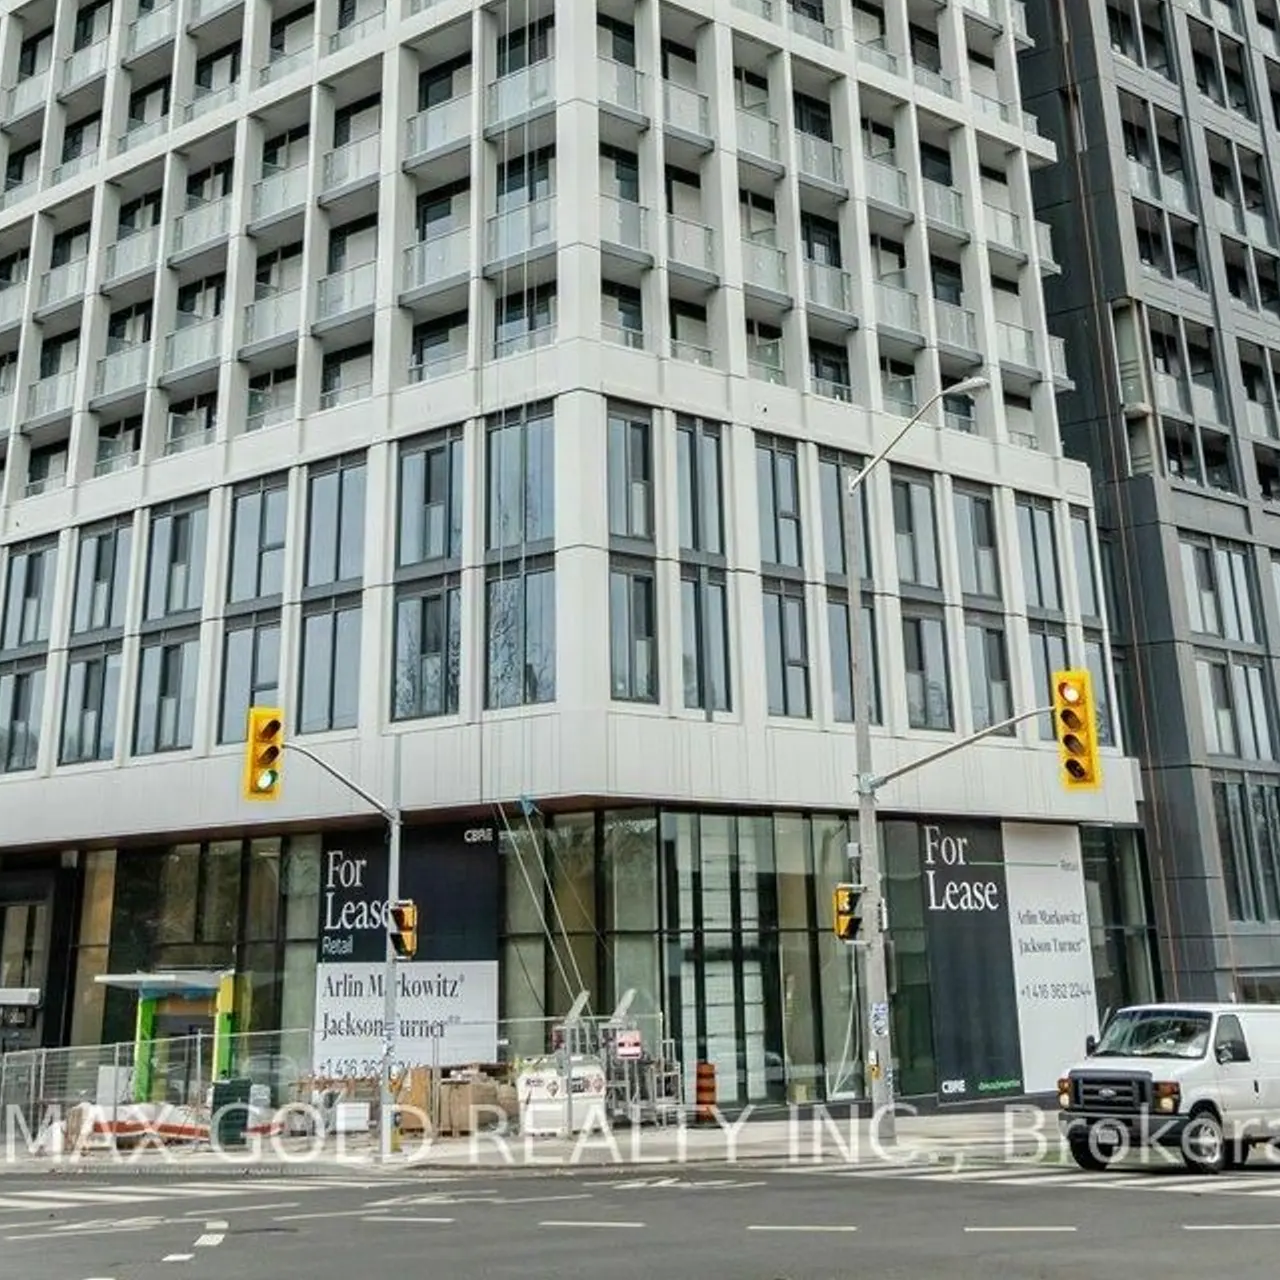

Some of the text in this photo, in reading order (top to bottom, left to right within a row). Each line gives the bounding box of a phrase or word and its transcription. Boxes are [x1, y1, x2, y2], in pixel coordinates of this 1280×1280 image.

[924, 825, 968, 866] For
[325, 850, 368, 888] For
[925, 870, 1000, 911] Lease
[322, 935, 353, 955] Retail
[322, 973, 363, 998] Arlin
[322, 1011, 383, 1041] Jackson
